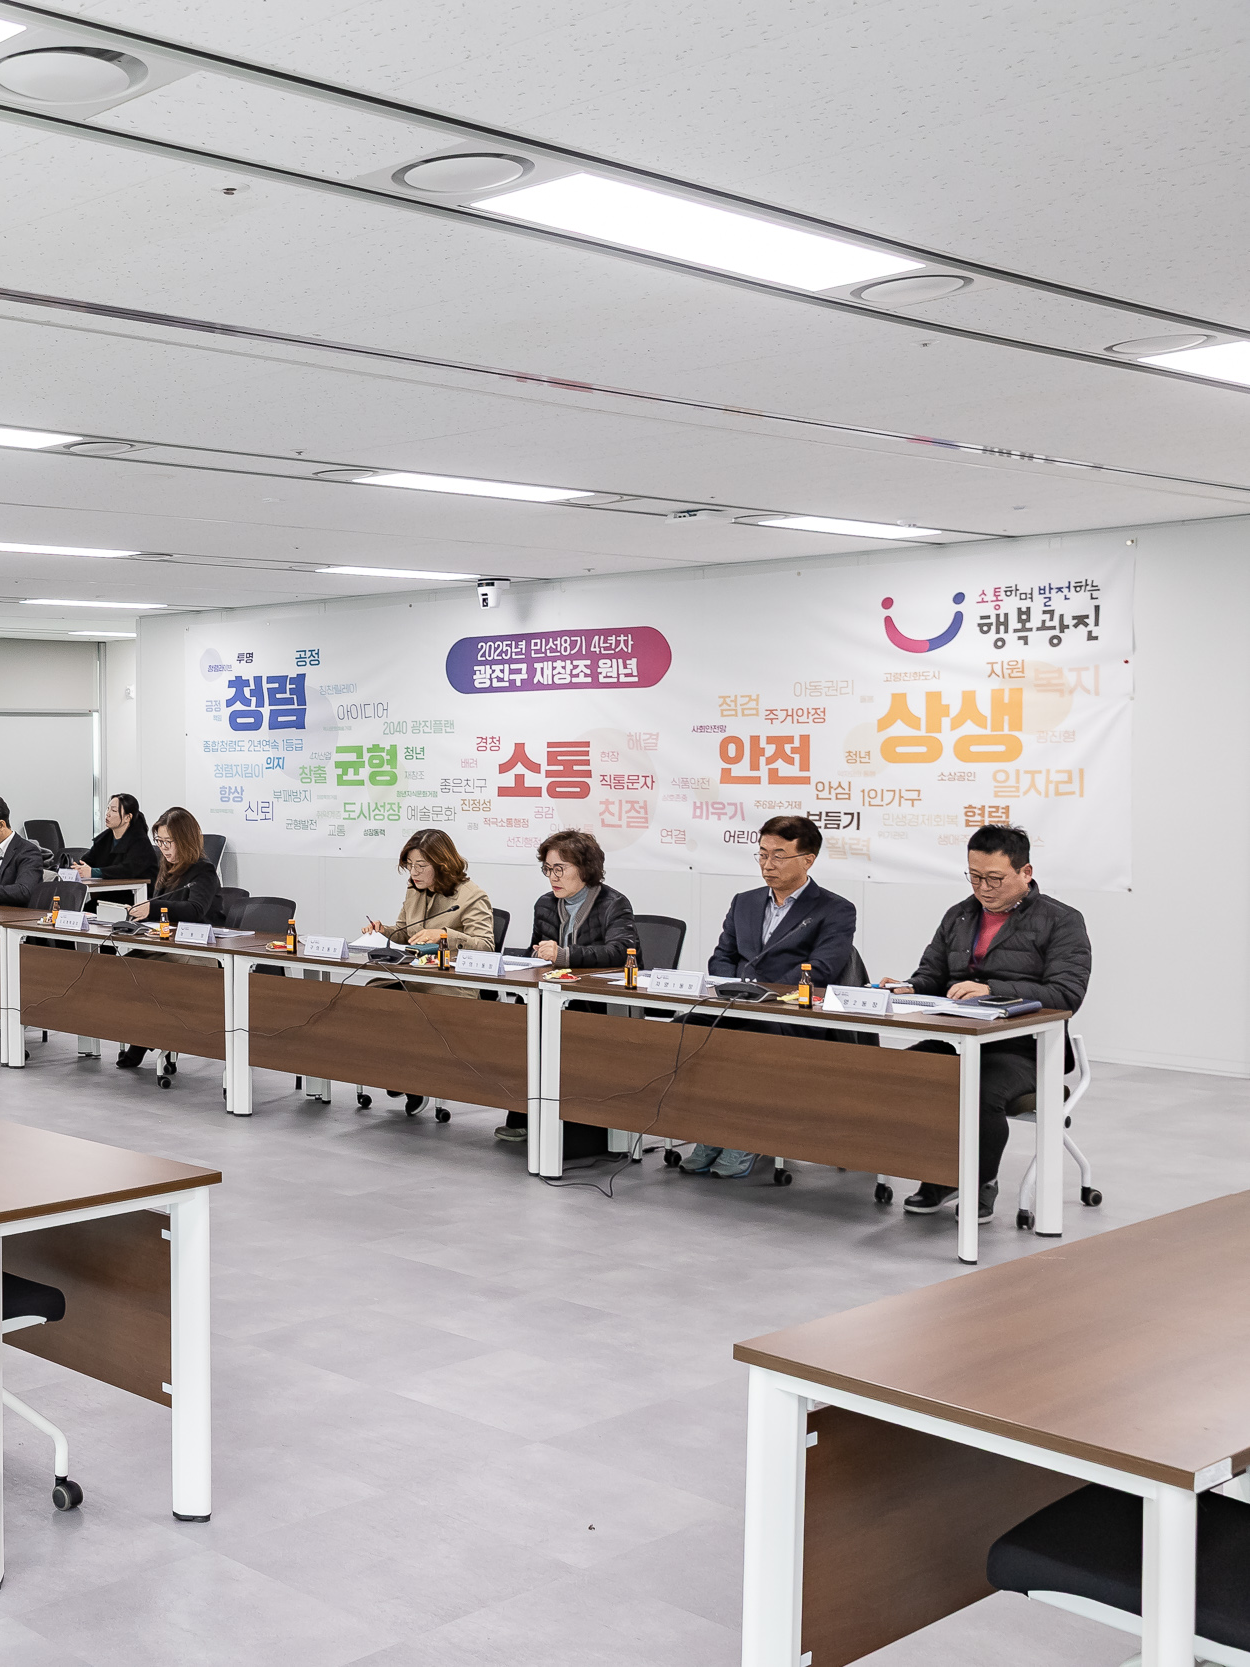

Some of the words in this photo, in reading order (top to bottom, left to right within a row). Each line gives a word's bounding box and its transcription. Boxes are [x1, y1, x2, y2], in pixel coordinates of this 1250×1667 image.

[976, 584, 1033, 611] 소통하며
[1038, 579, 1100, 607] 발전하는
[977, 605, 1100, 649] 행복광진
[477, 640, 526, 661] 2025년
[530, 635, 586, 658] 민선8기
[591, 634, 634, 654] 4년차
[237, 652, 254, 664] 투명
[295, 649, 320, 667] 공정
[473, 663, 528, 688] 광진구
[534, 660, 592, 685] 재창조
[598, 657, 639, 683] 원년
[884, 670, 940, 682] 고령친화도시
[986, 659, 1025, 679] 지원
[794, 680, 854, 697] 아동권리
[1034, 664, 1100, 698] 복지
[205, 700, 222, 712] 긍정
[226, 673, 307, 731] 청렴
[718, 694, 760, 717] 점검
[337, 702, 389, 720] 아이디어
[765, 707, 826, 725] 주거안정
[383, 721, 408, 735] 2040
[411, 720, 455, 734] 광진플랜
[692, 725, 727, 733] 사회안전망
[877, 687, 1023, 763] 상생
[203, 740, 245, 752] 종합청렴도
[247, 739, 280, 752] 2년연속
[282, 738, 304, 752] 1등급
[476, 736, 501, 752] 경청
[626, 732, 659, 751] 해결
[1036, 730, 1076, 744] 광진형
[404, 746, 425, 760] 청년
[600, 751, 620, 762] 현장
[719, 734, 811, 785] 안전
[845, 750, 870, 764] 청년
[214, 763, 264, 778] 청렴지킴이
[265, 756, 285, 770] 의지
[335, 744, 398, 786] 균형
[461, 758, 478, 768] 배려
[497, 741, 592, 799] 소통
[299, 765, 327, 784] 창출
[405, 771, 425, 780] 재창조
[599, 774, 655, 790] 직통문자
[937, 772, 976, 782] 소상공인
[440, 778, 487, 793] 좋은친구
[671, 777, 710, 790] 식품안전
[815, 781, 851, 800] 안심
[992, 768, 1084, 798] 일자리
[219, 785, 244, 803] 향상
[273, 789, 312, 803] 부패방지
[860, 789, 922, 807] 1인가구
[245, 800, 274, 821] 신뢰
[343, 802, 402, 821] 도시성장
[461, 799, 491, 812] 진정성
[534, 806, 555, 819] 공감
[692, 800, 745, 821] 비우기
[754, 800, 802, 810] 주6일수거제
[406, 805, 457, 822] 예술문화
[599, 798, 649, 829] 친절
[882, 813, 958, 827] 민생경제회복
[964, 804, 1010, 827] 협력
[285, 819, 317, 830] 균형발전
[328, 824, 345, 837] 교통
[483, 817, 529, 828] 적극소통행정
[363, 829, 385, 837] 성장동력
[660, 828, 686, 844] 연결
[507, 837, 541, 848] 선진행정
[826, 836, 871, 861] 활력
